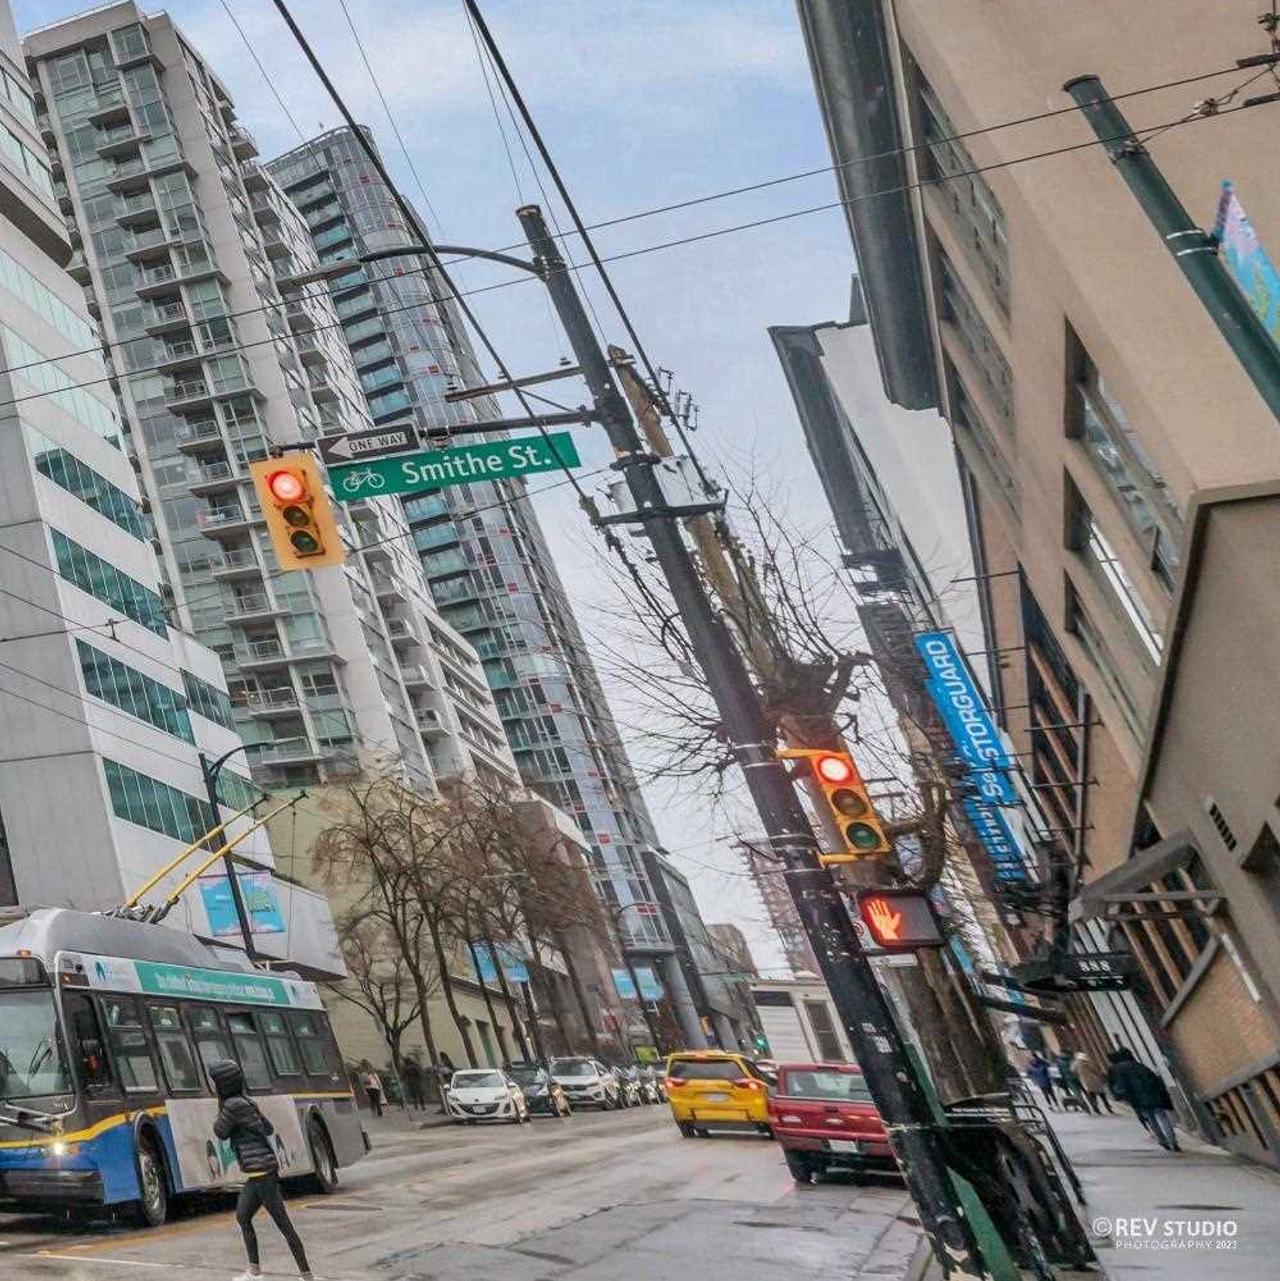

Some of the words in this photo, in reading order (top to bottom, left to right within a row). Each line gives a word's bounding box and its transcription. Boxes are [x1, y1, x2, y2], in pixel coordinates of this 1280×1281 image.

[349, 438, 374, 452] ONE
[378, 432, 406, 448] WAY
[402, 450, 503, 484] Smithe
[507, 445, 552, 469] St.
[926, 639, 1000, 761] STORGUARD
